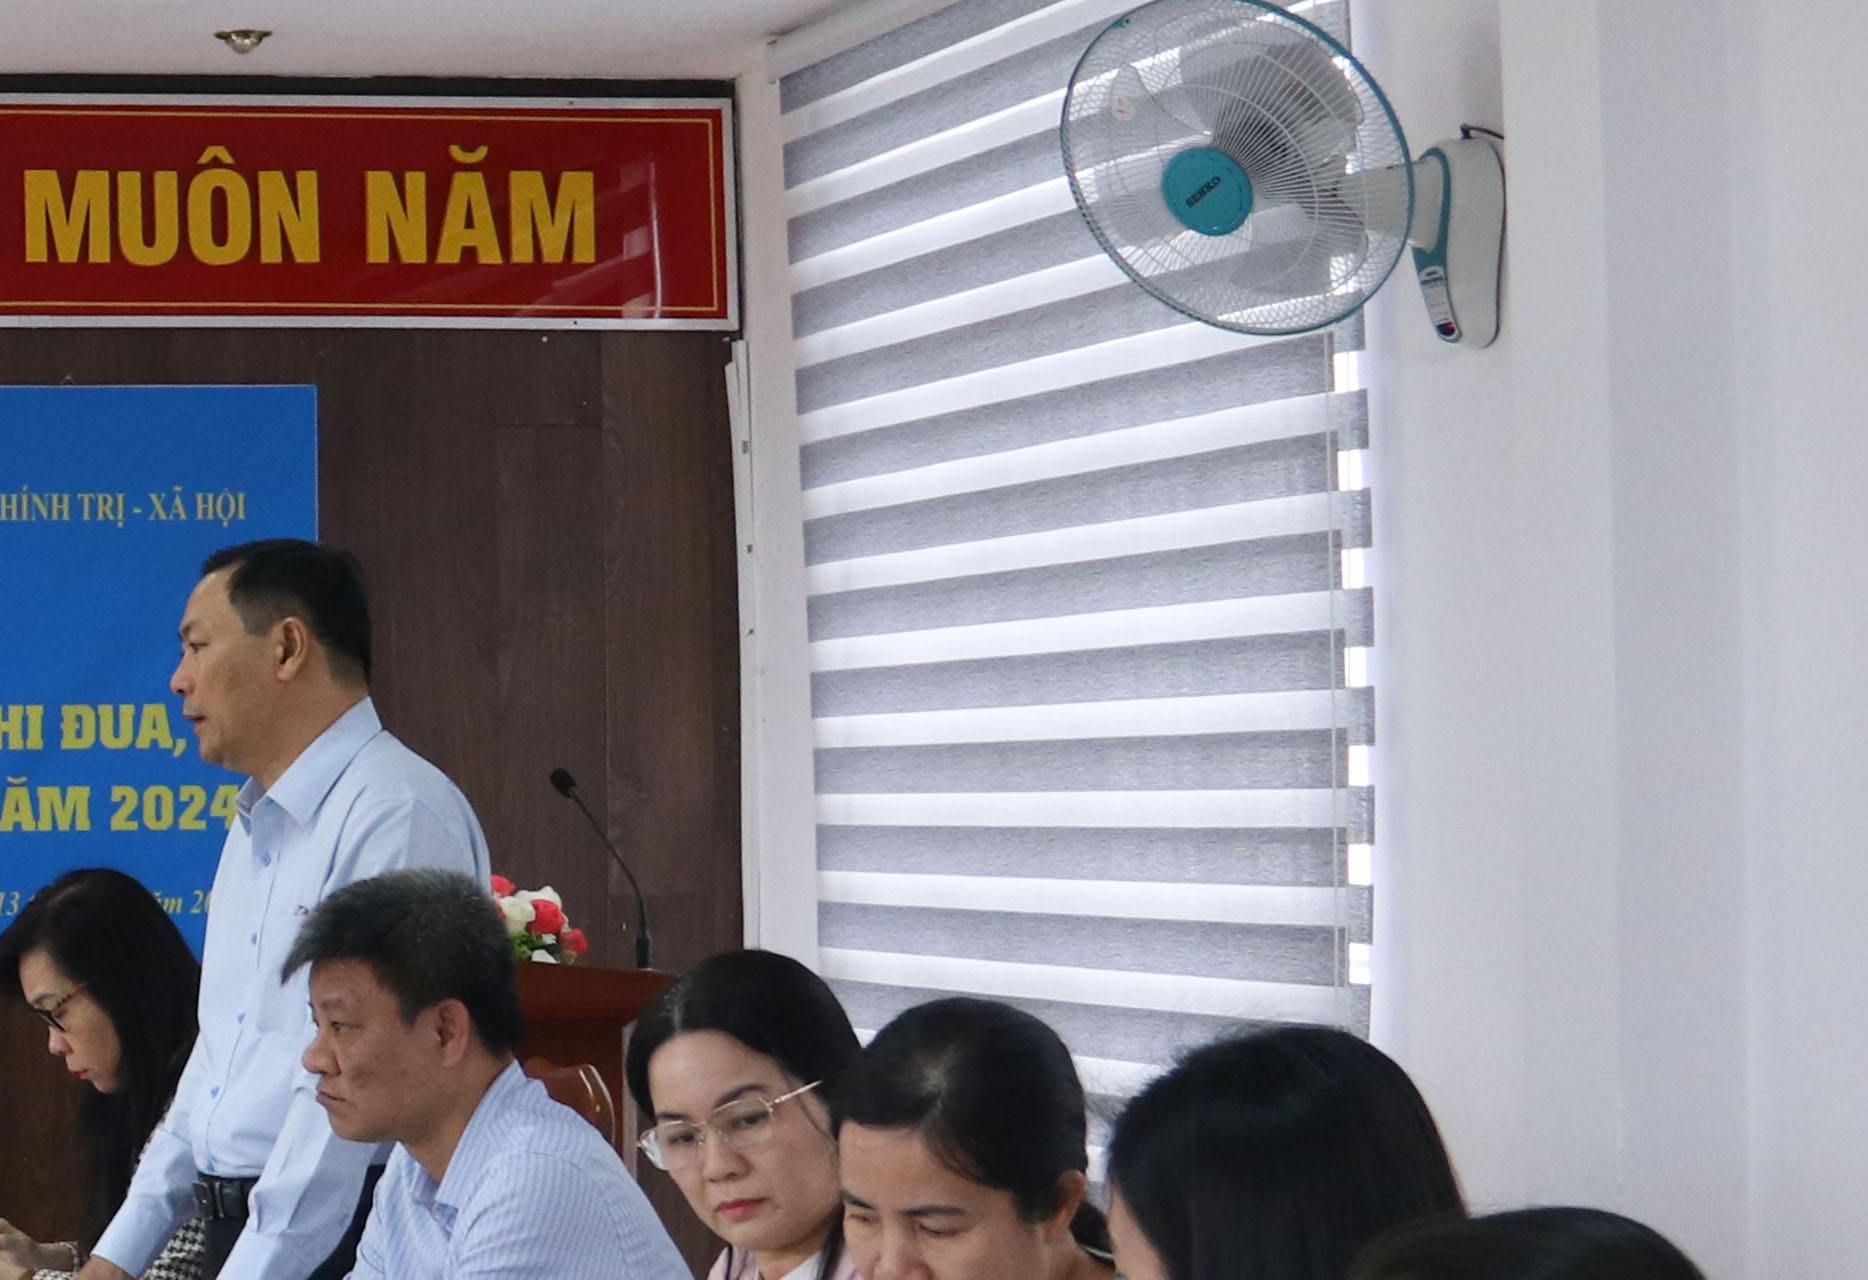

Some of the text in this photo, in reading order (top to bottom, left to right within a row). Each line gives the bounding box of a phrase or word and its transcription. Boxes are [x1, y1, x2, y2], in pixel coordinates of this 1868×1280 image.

[24, 144, 321, 267] MUÔN
[366, 144, 597, 266] NĂM
[77, 492, 127, 528] TRỊ
[148, 485, 189, 521] XÃ
[194, 487, 247, 528] HỘI
[60, 703, 187, 757] ĐUA,
[110, 784, 241, 832] 2024
